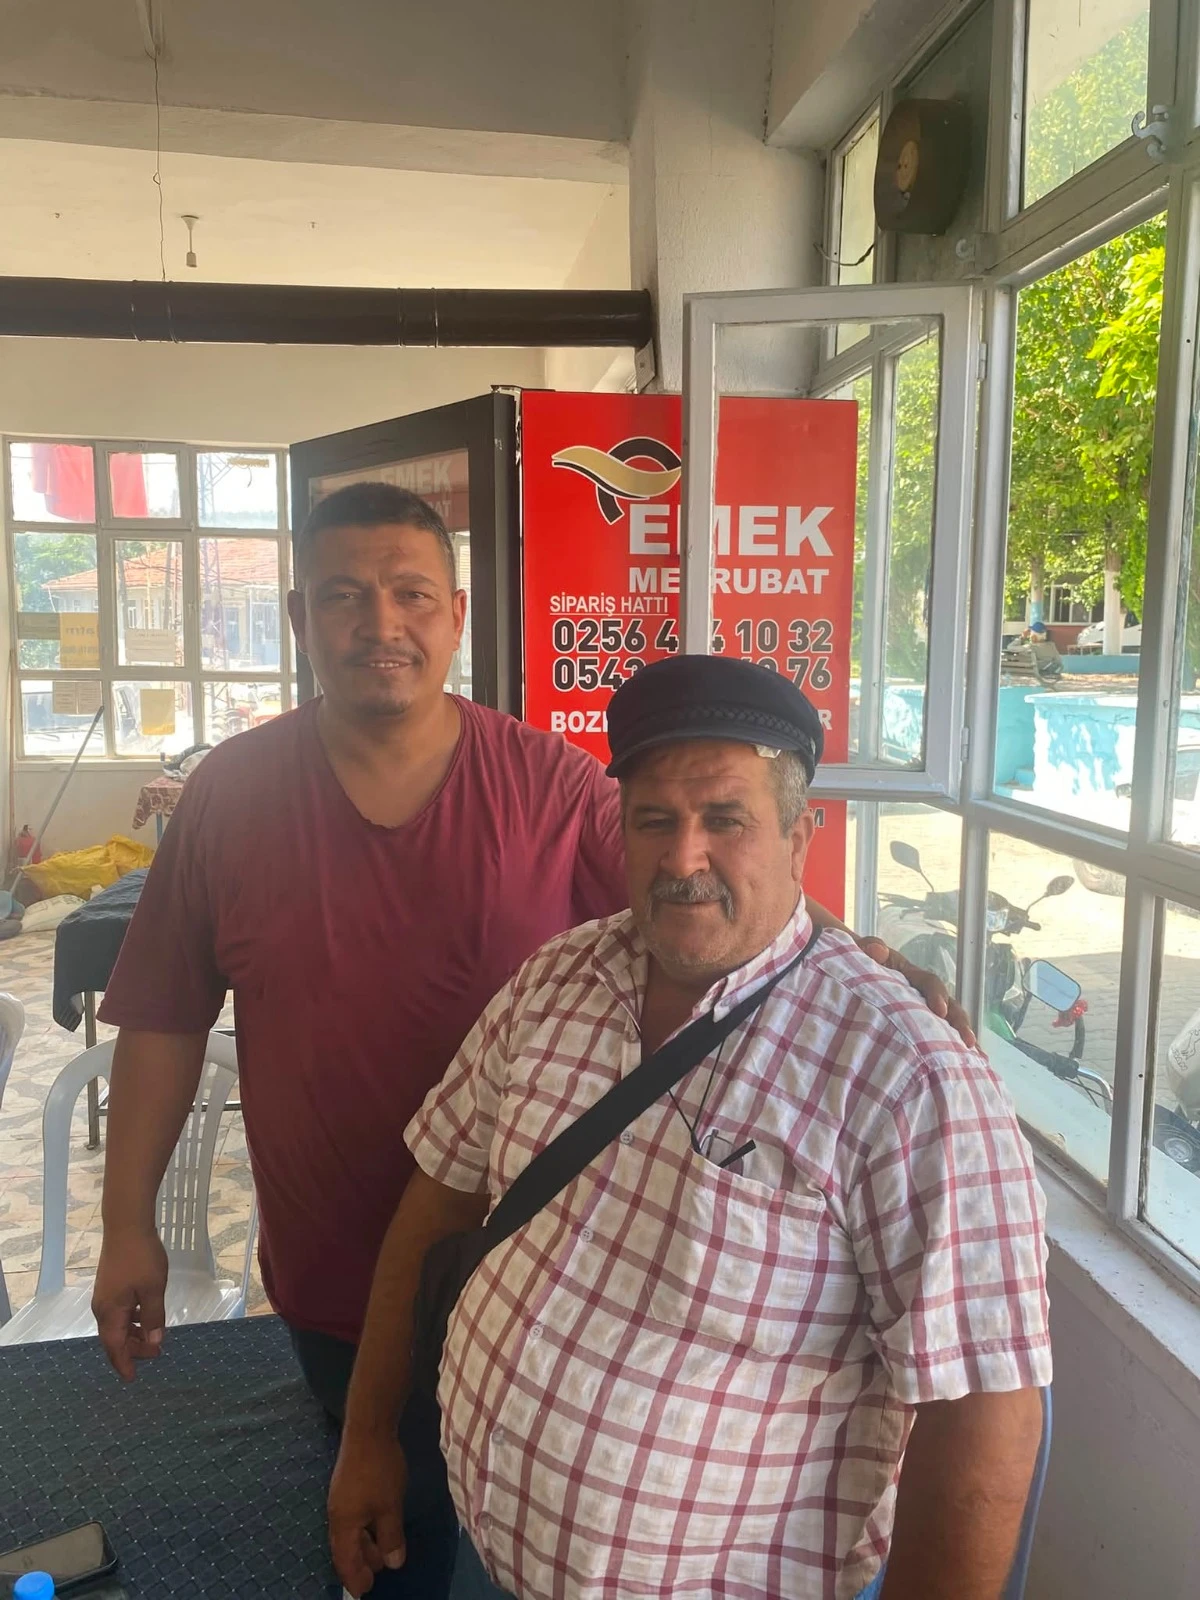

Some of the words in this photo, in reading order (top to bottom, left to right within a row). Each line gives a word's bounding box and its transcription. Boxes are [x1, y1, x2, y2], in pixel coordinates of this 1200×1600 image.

[629, 567, 829, 595] MERUBAT
[549, 592, 616, 617] SİPARİŞ
[621, 596, 668, 613] HATTI
[552, 618, 647, 653] 0256
[655, 618, 725, 653] 44
[735, 618, 780, 653] 10
[787, 618, 834, 653] 32
[786, 656, 833, 691] 76
